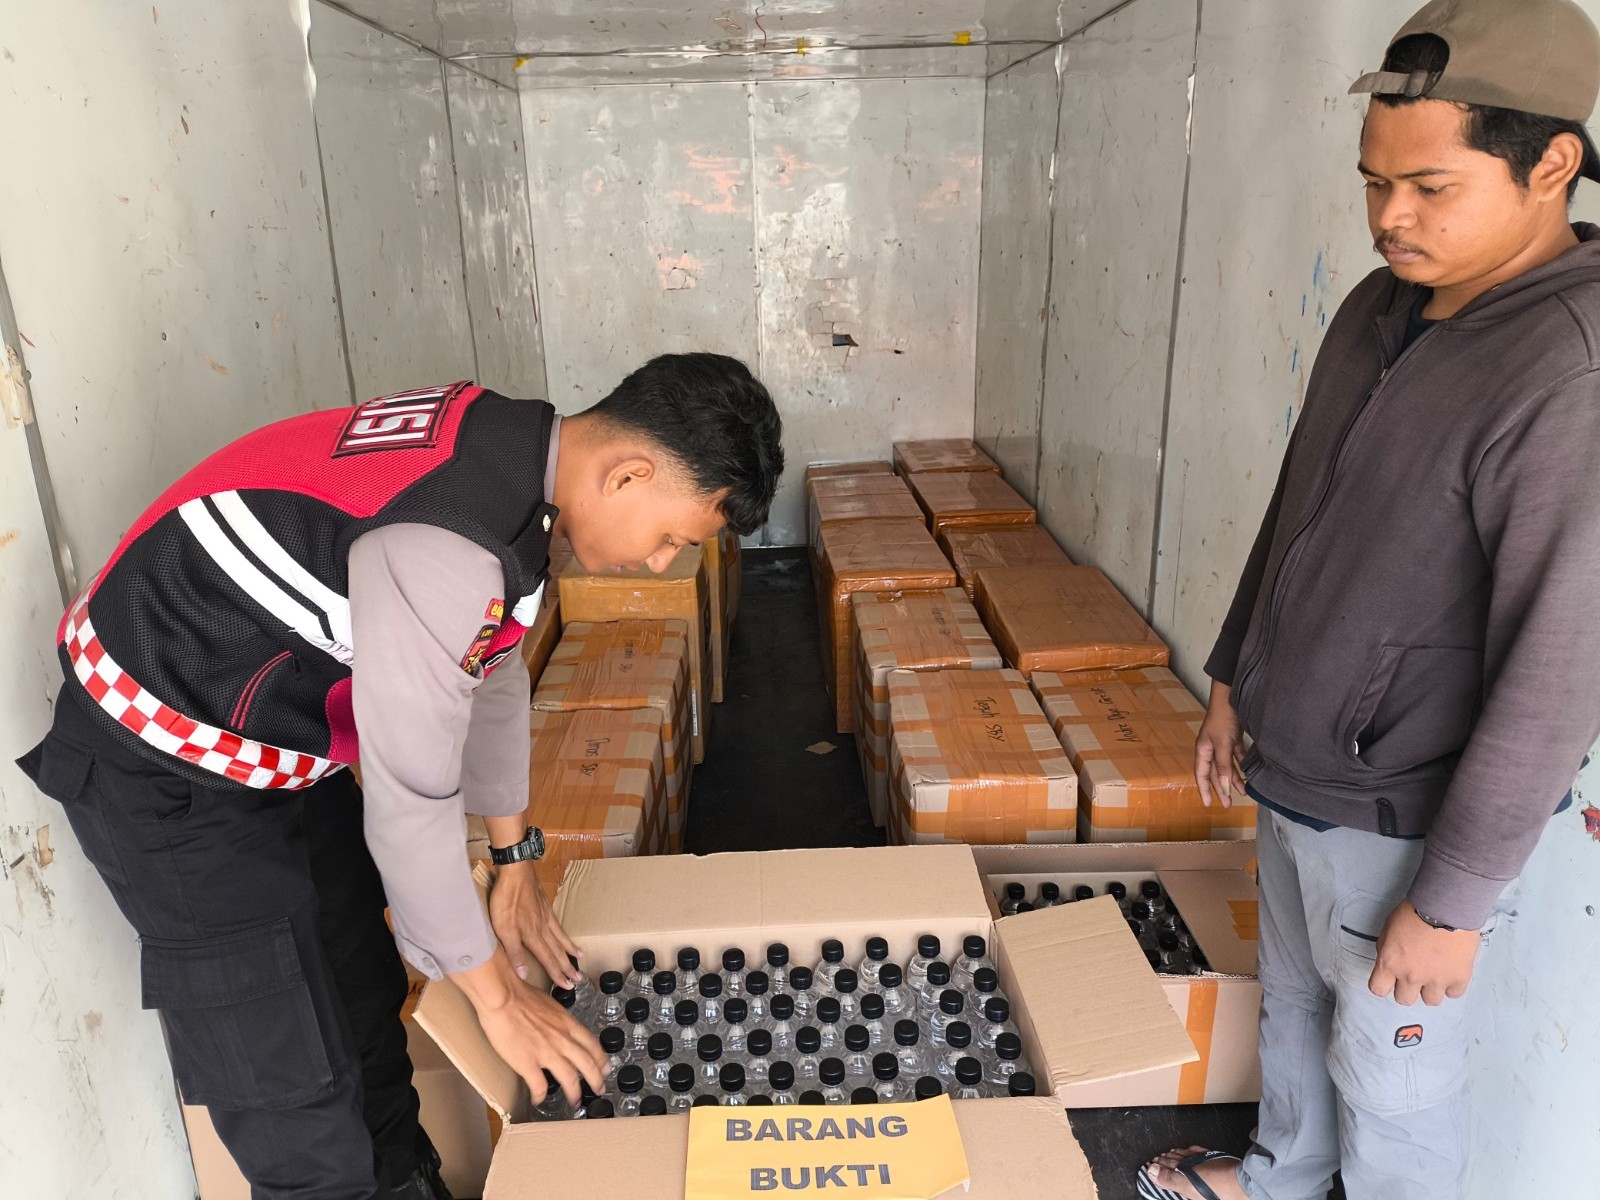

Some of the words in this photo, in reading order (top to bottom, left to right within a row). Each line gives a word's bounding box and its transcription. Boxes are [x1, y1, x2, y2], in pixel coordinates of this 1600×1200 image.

[345, 385, 450, 446] LISI
[726, 1115, 909, 1142] BARANG
[750, 1163, 892, 1191] BUKTI
